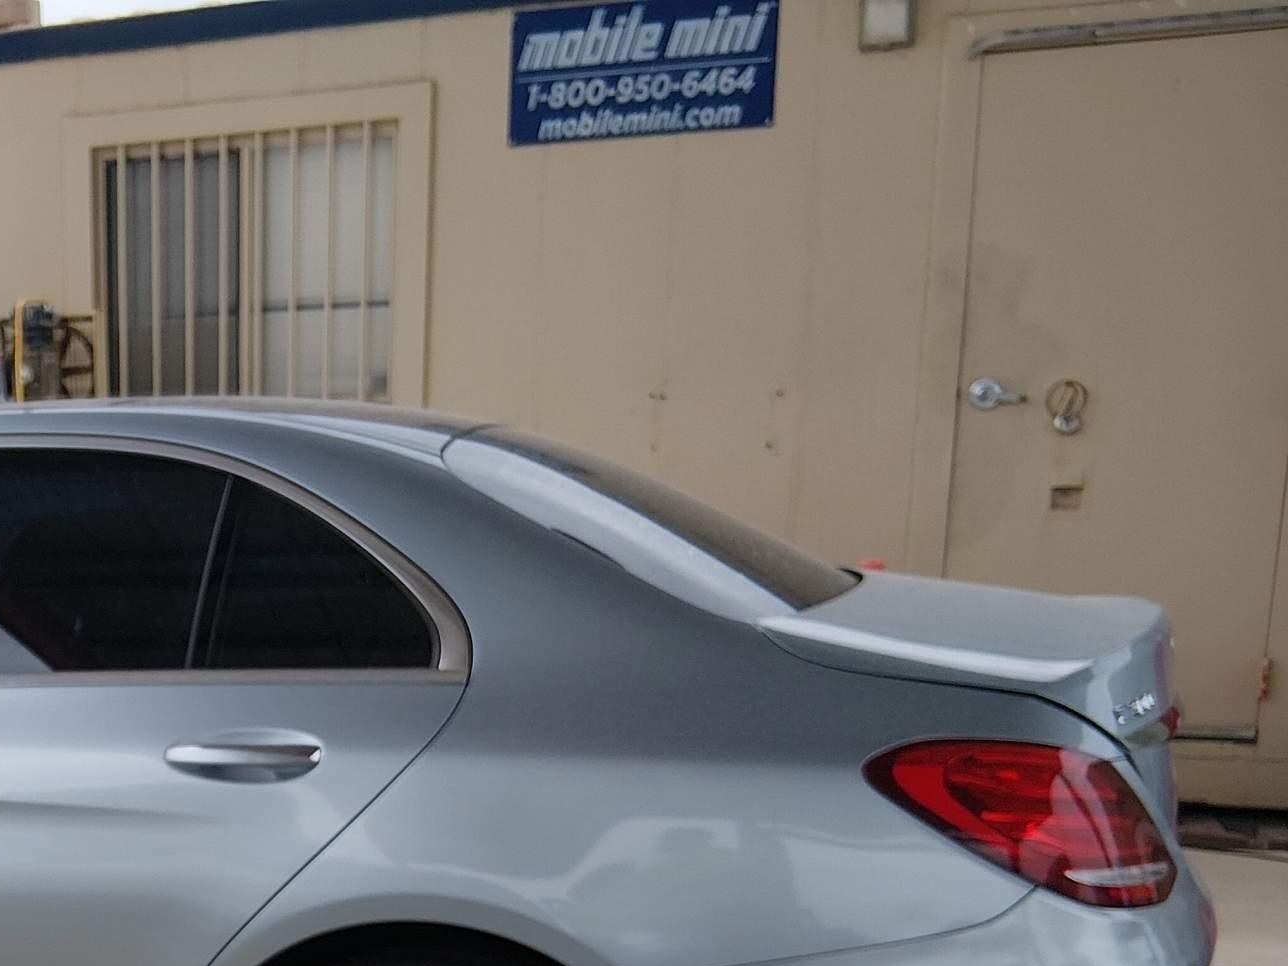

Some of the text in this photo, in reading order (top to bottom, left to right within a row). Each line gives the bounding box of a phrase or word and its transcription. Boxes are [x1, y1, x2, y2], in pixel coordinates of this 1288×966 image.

[517, 0, 777, 72] mobile mini
[527, 65, 756, 112] 1-800-950-6464
[537, 103, 742, 141] mobilemini.com
